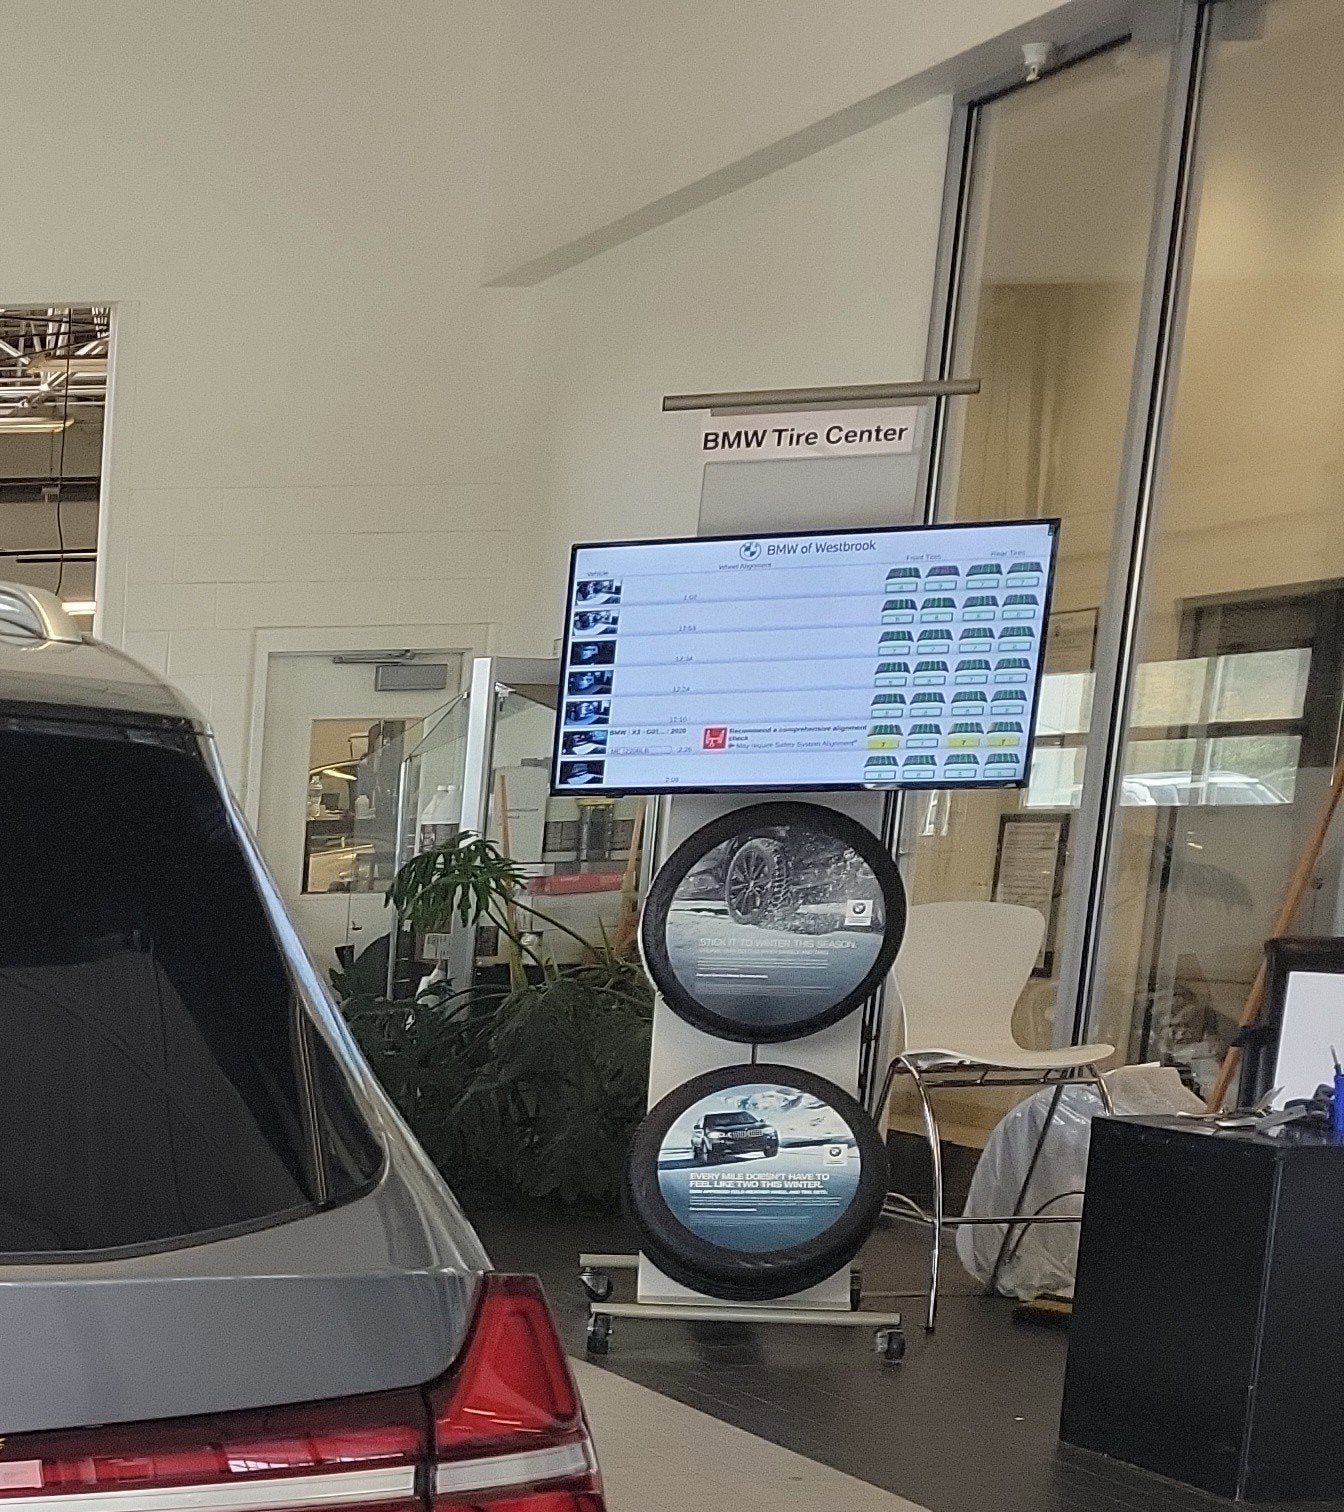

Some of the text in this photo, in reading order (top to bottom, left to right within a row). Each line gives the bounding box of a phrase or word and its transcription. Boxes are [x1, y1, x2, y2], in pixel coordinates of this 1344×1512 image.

[703, 425, 908, 450] BMW Tire Center
[767, 540, 876, 556] BMW of Westbrook
[746, 1173, 786, 1181] DOESN'T
[789, 1173, 813, 1181] HAVE
[816, 1173, 830, 1181] TO
[785, 1181, 823, 1189] WINTER.
